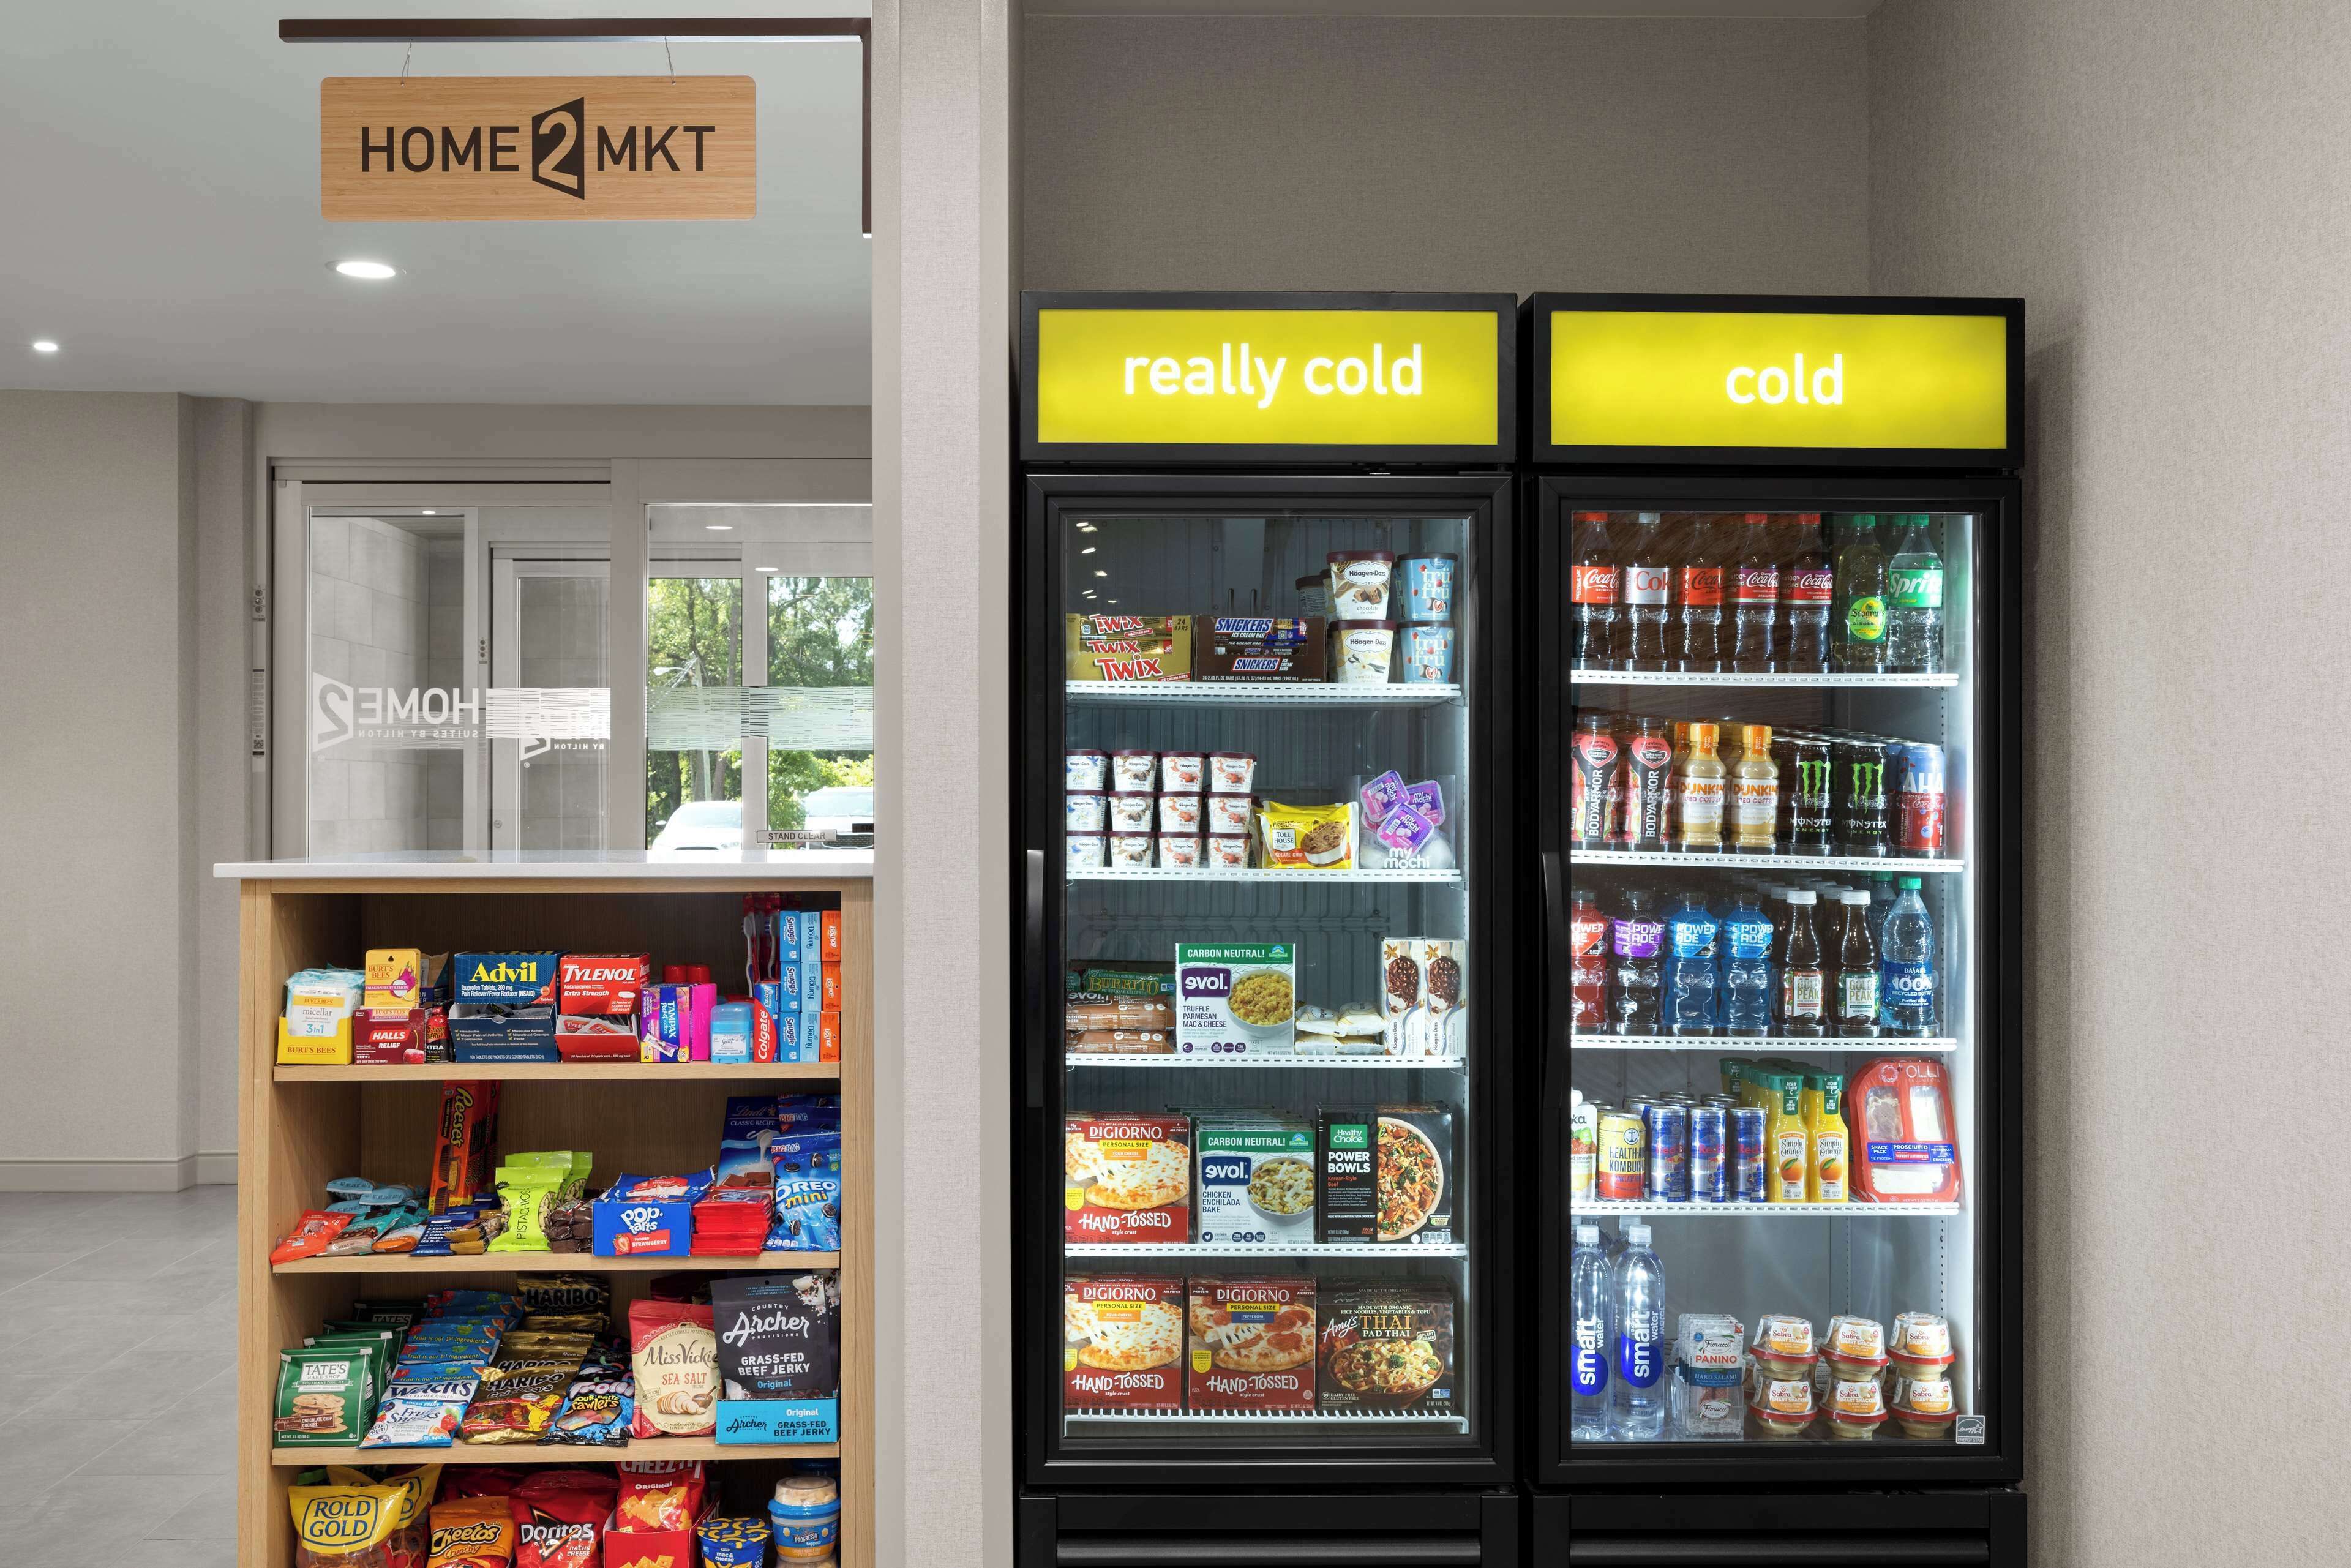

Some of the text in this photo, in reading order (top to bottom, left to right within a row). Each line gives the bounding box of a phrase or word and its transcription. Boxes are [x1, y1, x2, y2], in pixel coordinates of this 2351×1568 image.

[361, 126, 519, 172] HOME
[597, 126, 715, 171] MKT
[1125, 343, 1422, 410] really cold
[1726, 353, 1842, 404] cold
[1215, 618, 1272, 632] SNICKERS
[1903, 772, 1944, 793] AHA
[1589, 769, 1603, 836] BODYARMOR
[1384, 855, 1430, 869] mochi
[786, 916, 795, 944] Snuggle
[469, 962, 537, 983] Advil
[564, 965, 635, 983] TYLENOL
[1088, 977, 1159, 995] BURRITO
[1797, 989, 1818, 999] PEAK
[302, 1008, 332, 1016] micellar
[667, 1001, 676, 1038] TAMPAX
[758, 1010, 770, 1059] Colgate
[1906, 1065, 1940, 1078] OLLI
[1337, 1129, 1362, 1138] Healthy
[1328, 1152, 1370, 1161] POWER
[1739, 1144, 1758, 1153] Red
[1781, 1147, 1803, 1157] Orange
[1328, 1163, 1371, 1173] BOWLS
[776, 1181, 836, 1202] OREO
[786, 1191, 828, 1209] mini
[517, 1190, 530, 1239] PISTACHIOS
[526, 1288, 599, 1306] HARIBO
[723, 1311, 809, 1347] Archer
[1322, 1316, 1358, 1343] Amy's
[1360, 1316, 1411, 1329] THAI
[1634, 1310, 1650, 1378] smart
[644, 1340, 719, 1368] Miss Vickie
[741, 1353, 804, 1365] GRASS-FED
[1696, 1355, 1737, 1364] PANINO
[305, 1364, 346, 1375] TATE'S
[738, 1363, 810, 1376] BEEF JERKY
[662, 1373, 707, 1385] SEA SALT
[757, 1379, 792, 1389] Original
[313, 1501, 371, 1517] ROLD
[310, 1521, 367, 1537] GOLD
[522, 1523, 594, 1544] Doritos
[431, 1525, 500, 1553] Cheetos
[795, 1533, 817, 1543] PROGRESSO
[444, 1545, 479, 1558] Crunchy
